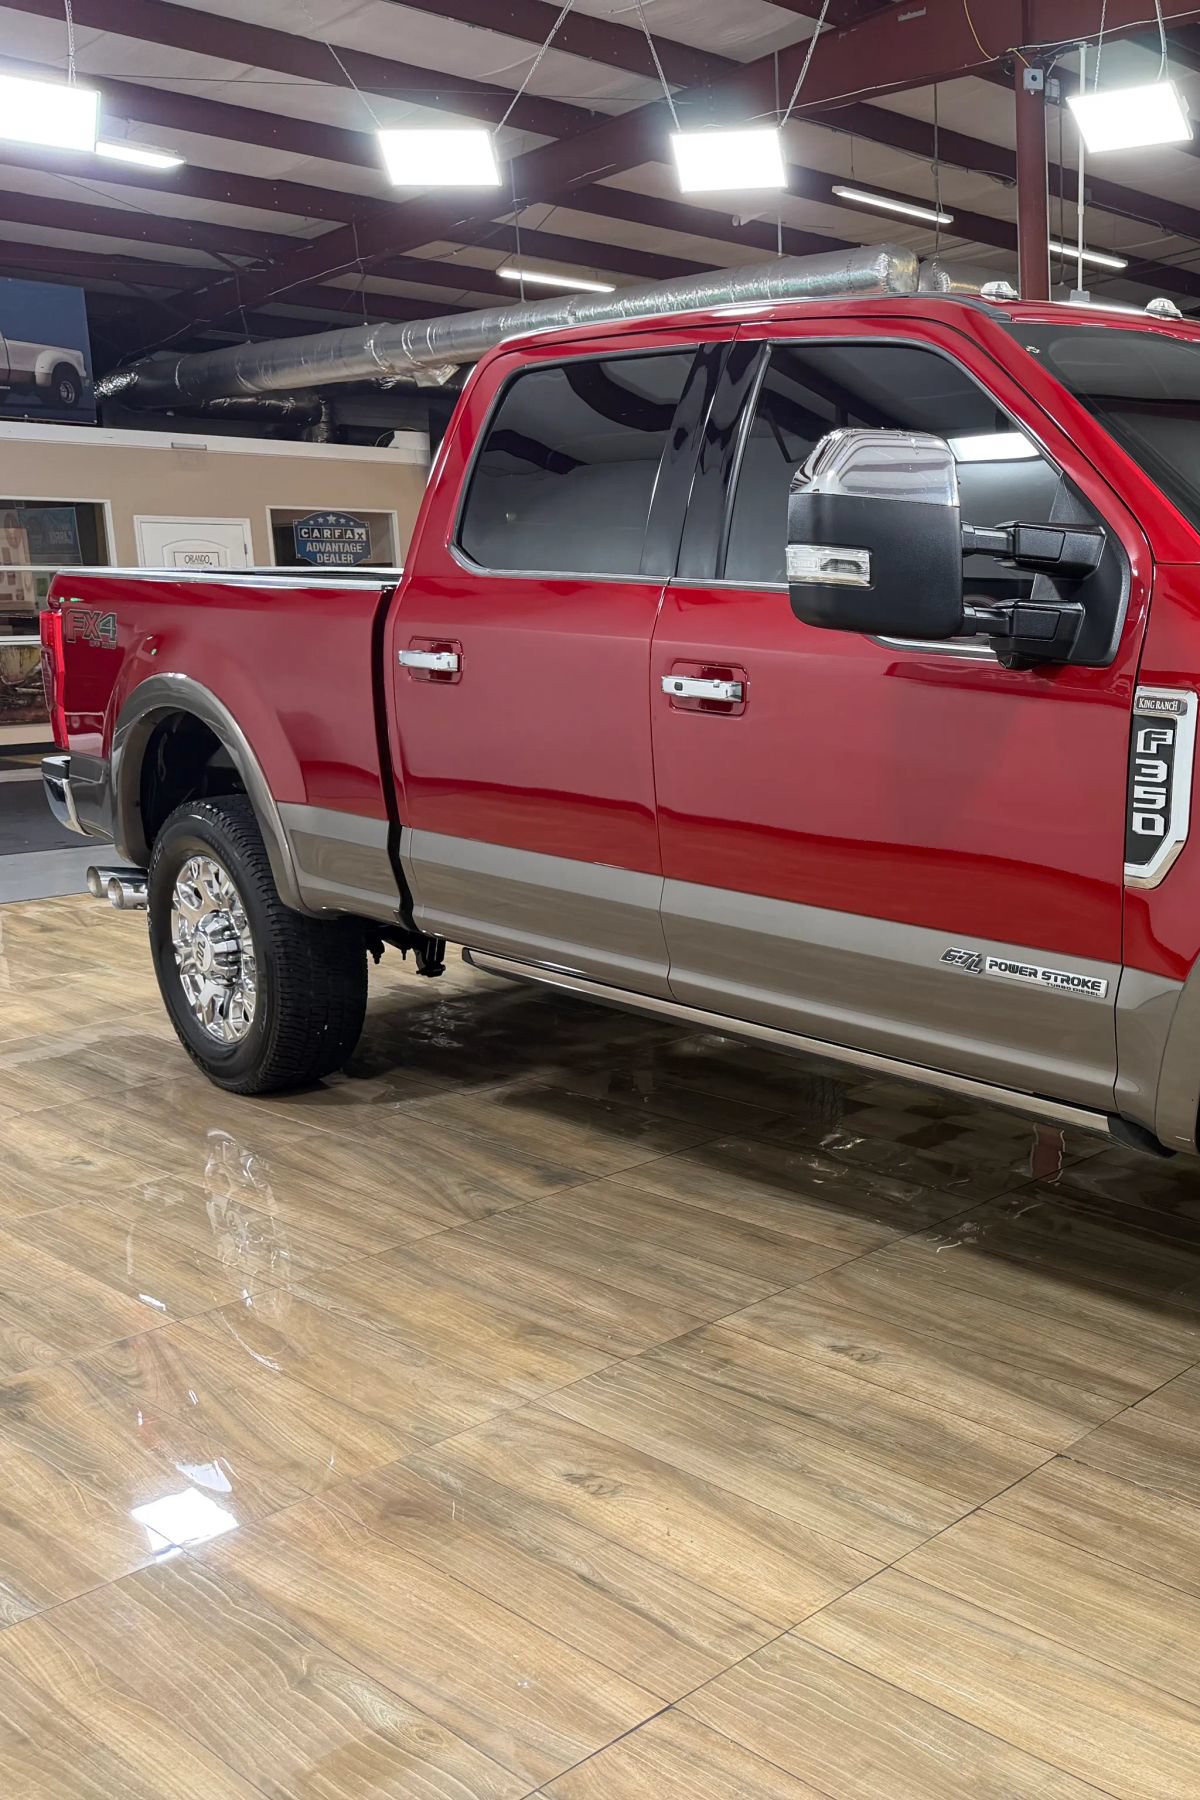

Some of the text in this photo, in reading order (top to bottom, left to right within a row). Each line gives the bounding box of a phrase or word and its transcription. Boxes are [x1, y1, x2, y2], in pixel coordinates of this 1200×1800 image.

[300, 528, 366, 540] CARFAX
[316, 553, 354, 563] DEALER
[65, 608, 117, 643] FX4
[1138, 698, 1178, 711] KING RANCH
[1132, 728, 1174, 836] F350
[940, 947, 983, 974] 6.7L
[988, 960, 1102, 992] POWER STROKE
[1046, 982, 1100, 997] TURBO DIESEL
